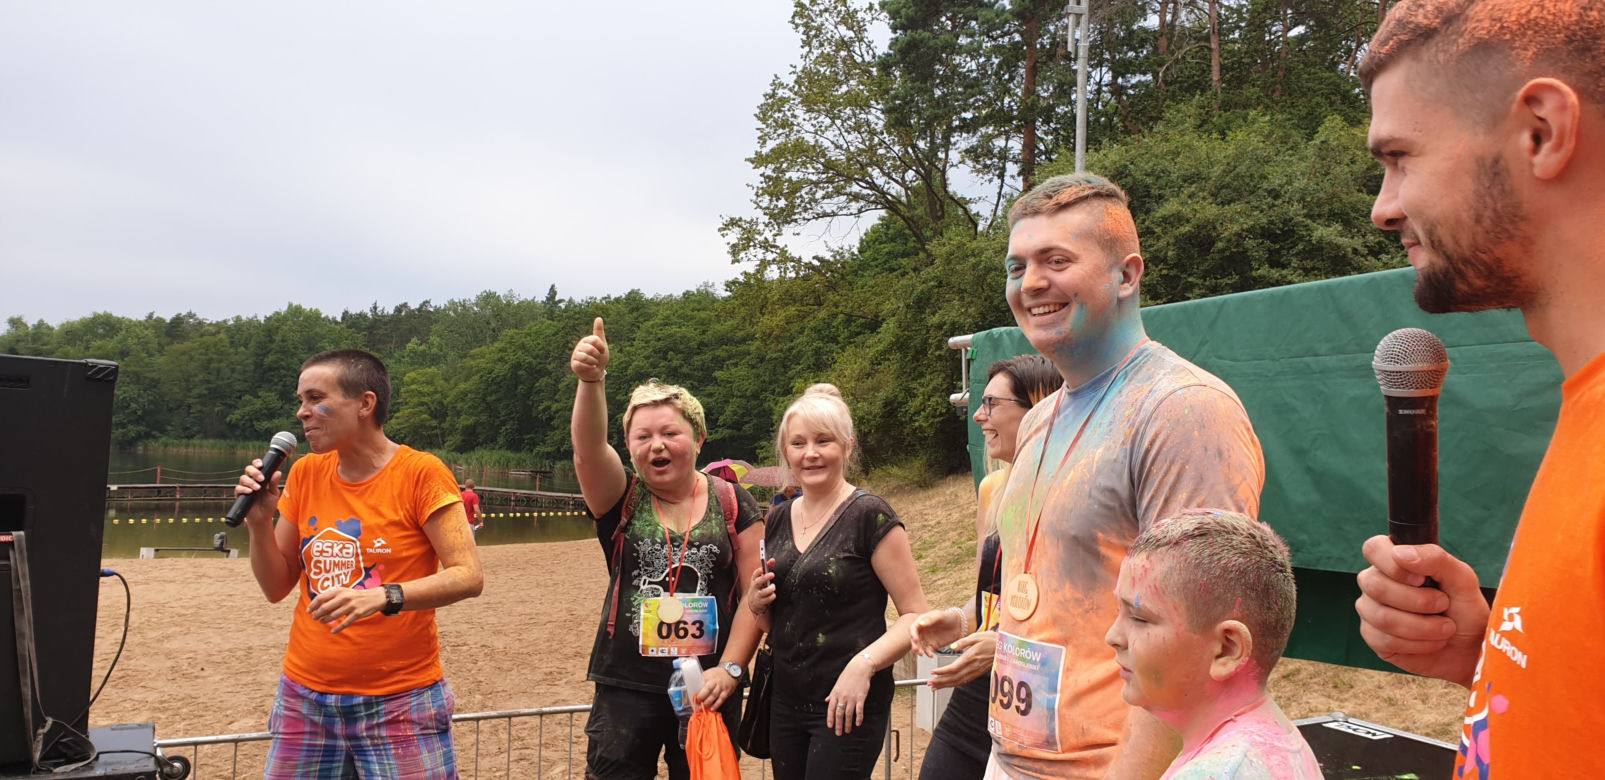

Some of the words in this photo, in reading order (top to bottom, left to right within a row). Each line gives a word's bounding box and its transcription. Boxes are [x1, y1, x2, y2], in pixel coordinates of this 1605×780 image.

[312, 541, 354, 558] eska
[312, 559, 355, 576] SUMMER
[319, 571, 351, 592] CITY
[657, 620, 705, 640] 063
[1003, 641, 1042, 663] KOLORÓW
[1489, 628, 1528, 669] AURON
